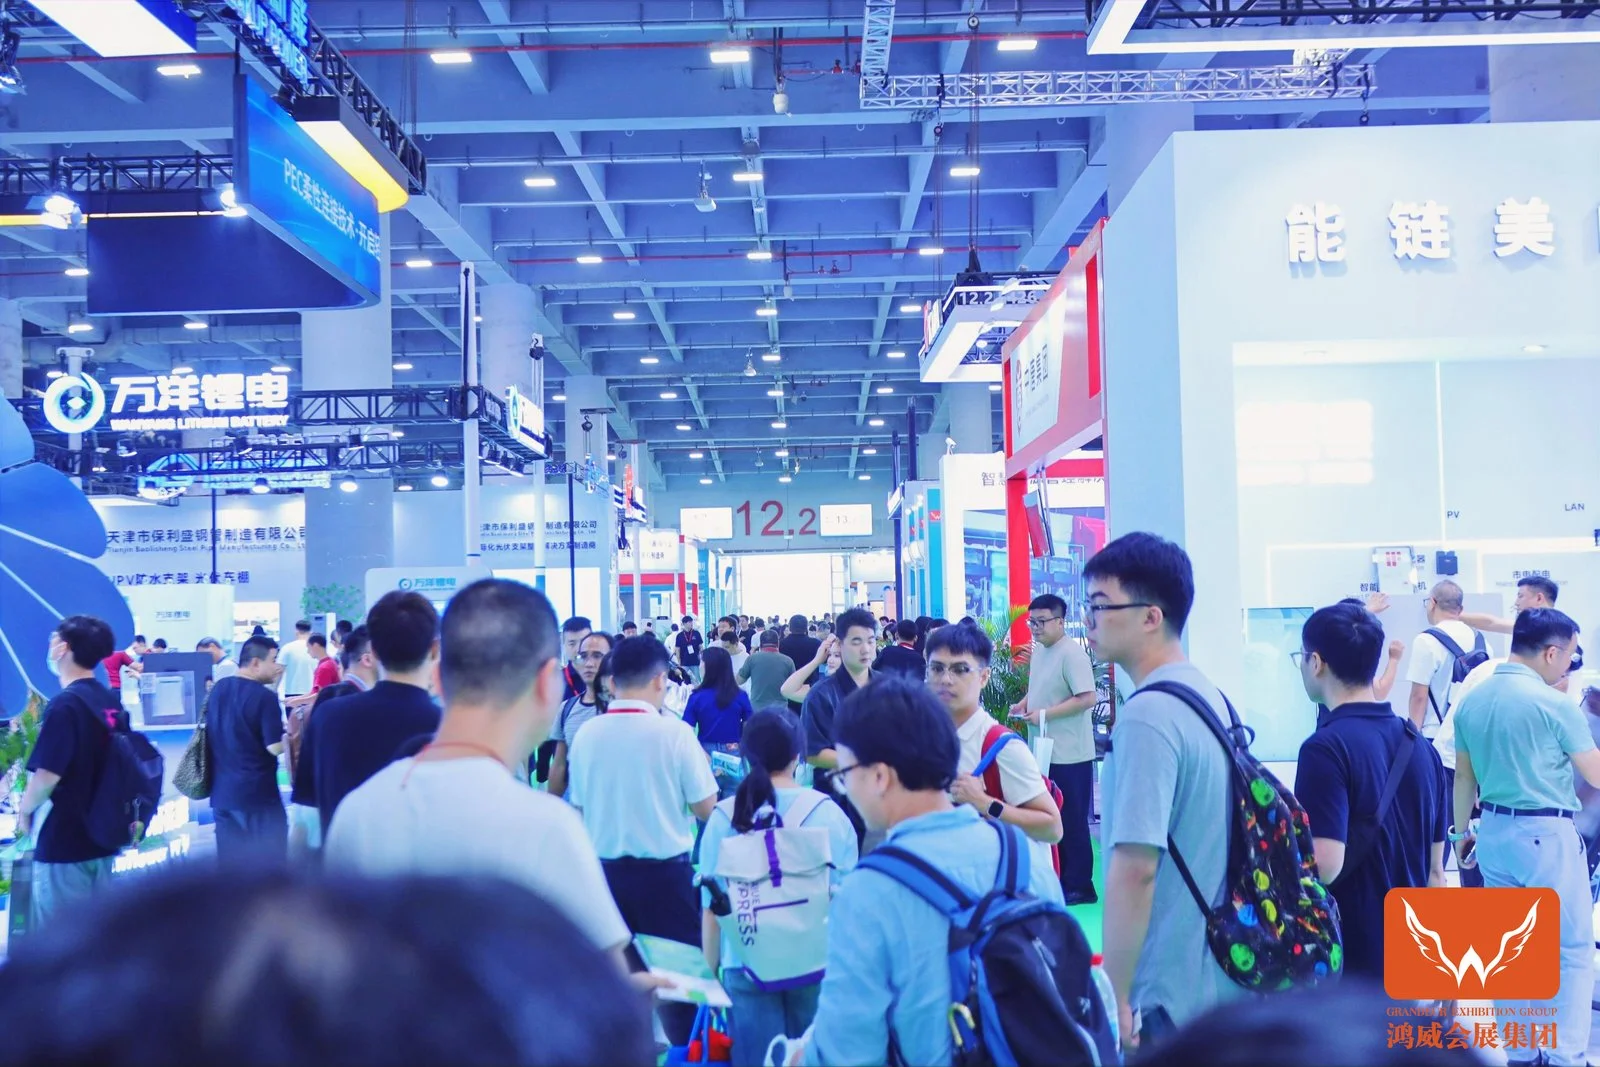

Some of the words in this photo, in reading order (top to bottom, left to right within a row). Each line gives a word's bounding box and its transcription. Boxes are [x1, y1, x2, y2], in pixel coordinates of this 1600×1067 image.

[1285, 195, 1600, 263] 能链美
[110, 372, 289, 413] 万洋锂电
[230, 414, 289, 428] BATTERY
[736, 500, 817, 536] 12.2
[1446, 510, 1460, 519] PV
[1564, 503, 1585, 511] LAN
[481, 520, 597, 531] 津市保利盛钢制造有限公司
[737, 881, 755, 946] PRESS
